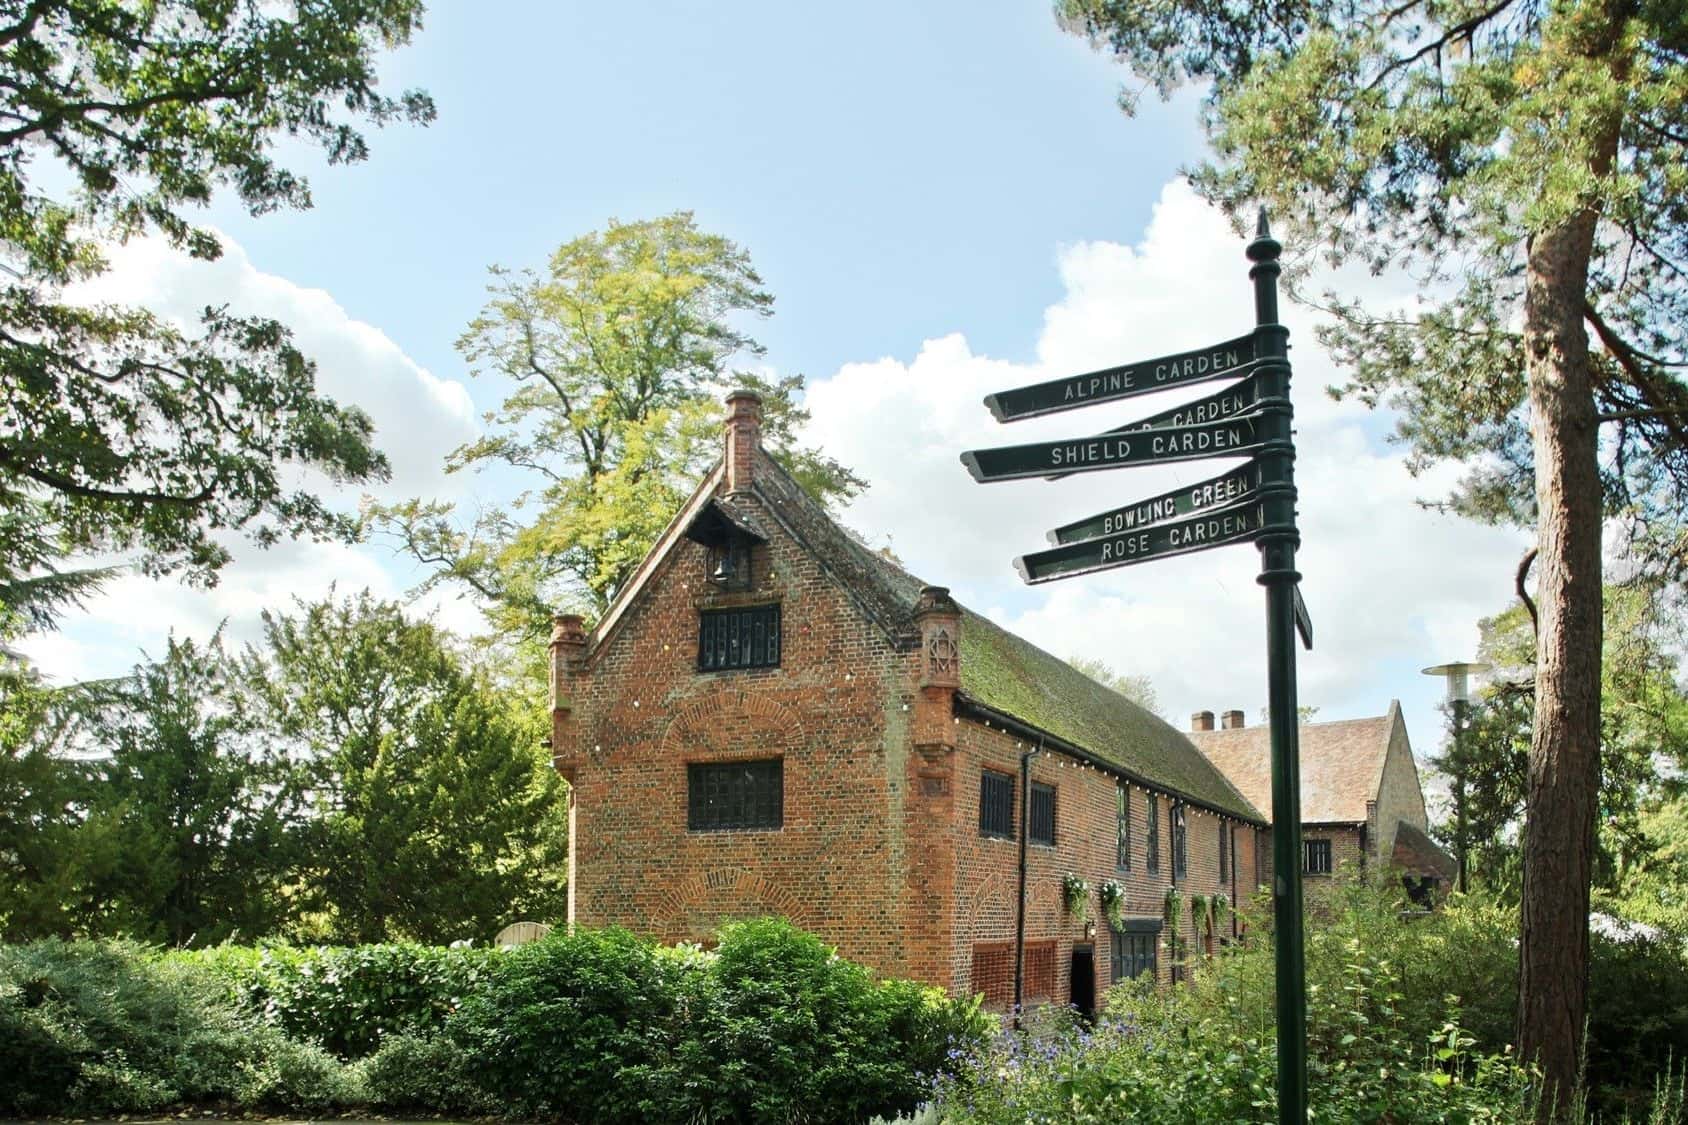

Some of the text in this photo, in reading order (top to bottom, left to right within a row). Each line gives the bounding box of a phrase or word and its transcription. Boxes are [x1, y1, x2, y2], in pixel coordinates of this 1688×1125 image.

[1064, 350, 1240, 401] ALPINE GARDEN
[1173, 393, 1244, 427] GARDEN
[1051, 428, 1241, 465] SHIELD GARDEN
[1104, 477, 1248, 534] BOWLING GREEN
[1102, 516, 1247, 560] ROSE GARDEN
